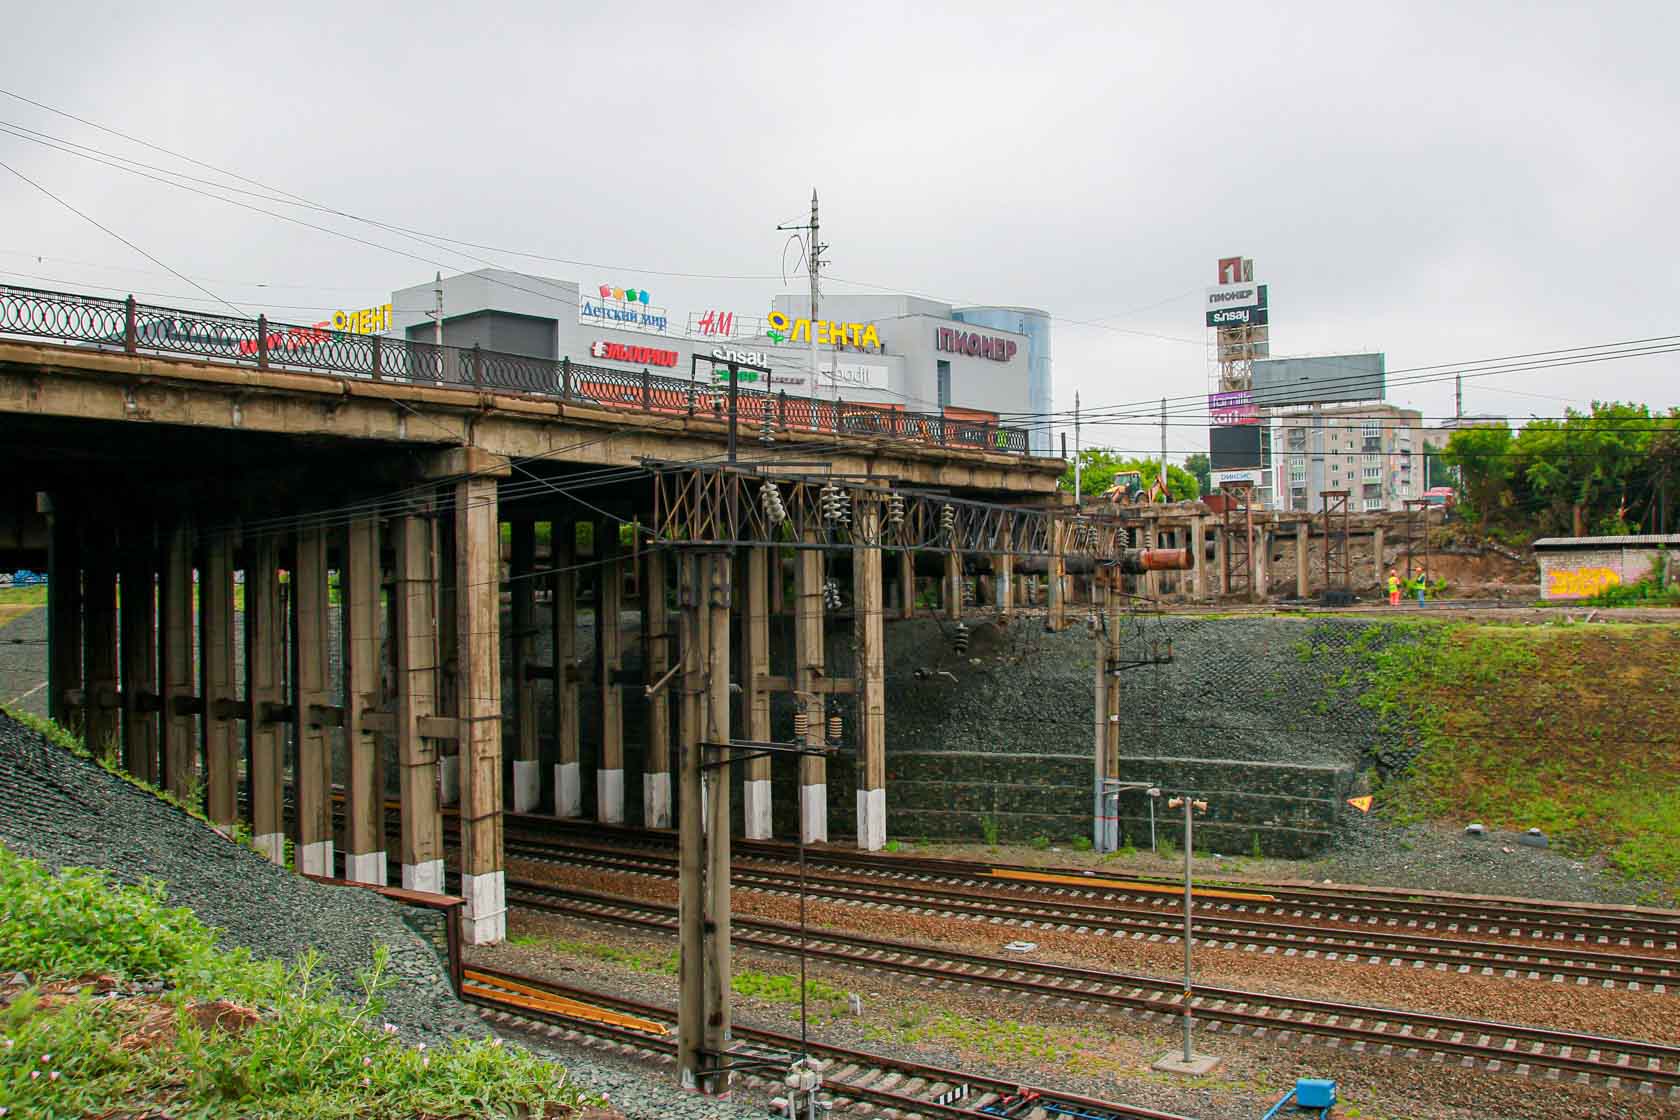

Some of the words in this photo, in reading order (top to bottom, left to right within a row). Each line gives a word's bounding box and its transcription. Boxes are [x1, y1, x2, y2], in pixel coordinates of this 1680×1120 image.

[1209, 289, 1253, 304] ПИОНЕР
[581, 301, 637, 323] Детский
[638, 314, 667, 331] мир
[697, 310, 733, 336] H&M
[1213, 308, 1250, 322] sinsay
[789, 319, 881, 349] ЛЕНТА
[936, 326, 1017, 362] ПИОНЕР
[712, 346, 767, 368] sinsay
[1209, 410, 1239, 424] kari
